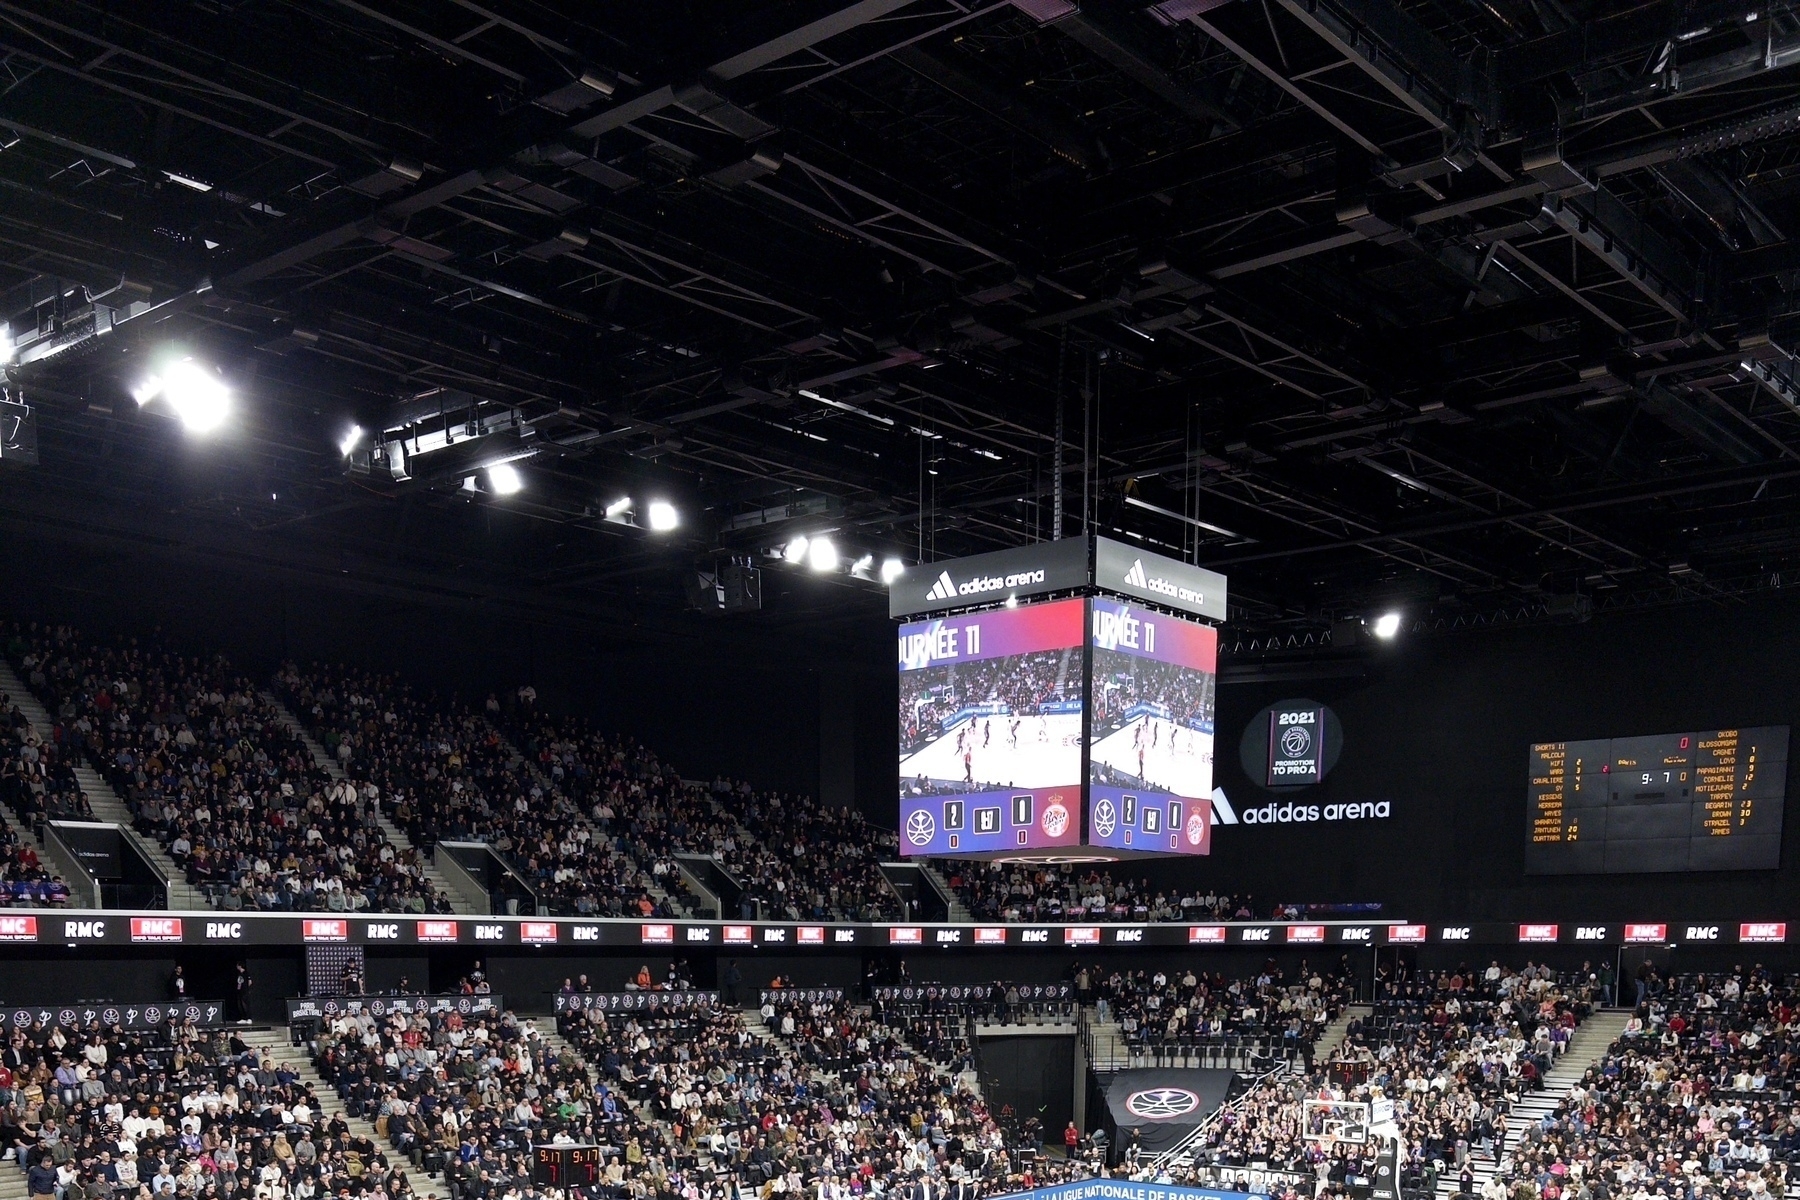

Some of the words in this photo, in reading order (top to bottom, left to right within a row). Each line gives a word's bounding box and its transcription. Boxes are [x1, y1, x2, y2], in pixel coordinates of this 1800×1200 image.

[958, 575, 1004, 596] adidas
[1006, 568, 1045, 588] arena
[1147, 578, 1177, 598] adidas
[1178, 587, 1204, 605] arena
[966, 625, 980, 654] 11
[1144, 622, 1155, 652] 11
[1279, 712, 1315, 725] 2021
[1272, 767, 1286, 775] TO
[1287, 766, 1307, 775] PRO
[1308, 766, 1316, 774] A
[951, 805, 957, 826] 2
[1243, 802, 1320, 825] adidas
[1323, 801, 1391, 821] arena
[0, 919, 26, 933] MC
[65, 922, 104, 937] RMC
[141, 921, 172, 935] RMC
[207, 923, 241, 938] RMC
[312, 923, 339, 935] RMC
[368, 924, 398, 938] RMC
[425, 924, 450, 936] RMC
[527, 925, 550, 937] RMC
[1294, 926, 1318, 937] RMC
[1395, 926, 1419, 936] RMC
[1527, 925, 1551, 937] RMC
[1632, 925, 1659, 937] RMC
[1751, 925, 1777, 937] RMC
[476, 926, 503, 939] RMC
[574, 927, 598, 940] RMC
[688, 928, 709, 940] RMC
[765, 930, 785, 941] RMC
[836, 930, 854, 941] RMC
[937, 931, 960, 941] RMC
[1022, 931, 1048, 941] RMC
[1117, 930, 1142, 941] RMC
[1243, 929, 1269, 940] RMC
[1342, 929, 1370, 939] RMC
[1443, 928, 1469, 939] RMC
[1576, 928, 1605, 939] RMC
[1686, 927, 1718, 939] RMC
[540, 1150, 560, 1163] 9:17
[573, 1149, 598, 1163] 9:17
[549, 1165, 556, 1182] 7
[585, 1164, 593, 1180] 7
